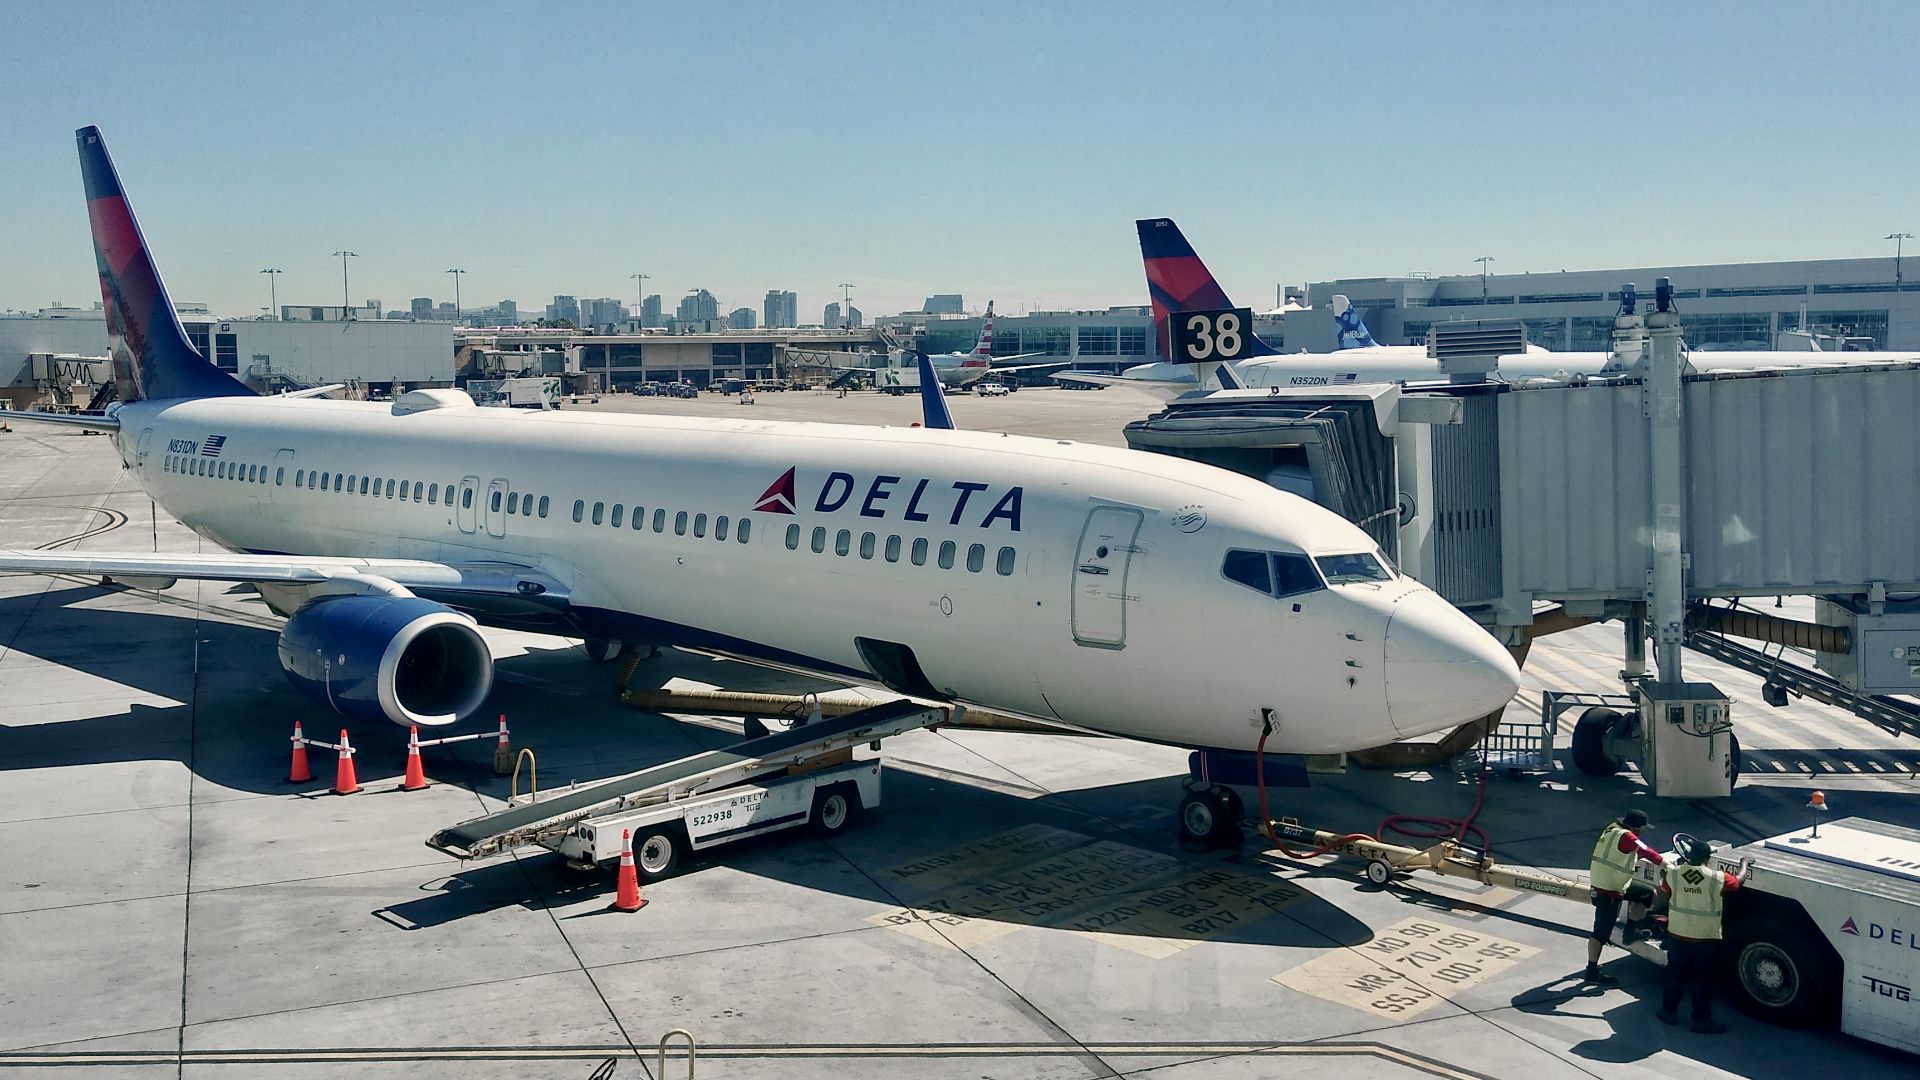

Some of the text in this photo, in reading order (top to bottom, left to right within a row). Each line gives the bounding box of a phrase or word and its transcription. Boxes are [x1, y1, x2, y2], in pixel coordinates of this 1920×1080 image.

[1187, 312, 1242, 359] 38
[1290, 376, 1329, 385] N352DN
[167, 438, 199, 455] N831DN
[814, 471, 1024, 532] DELTA
[740, 791, 769, 804] DELTA
[693, 809, 733, 826] 522938
[1530, 883, 1566, 895] EQUIPPED
[1365, 923, 1441, 954] MD 90
[1870, 922, 1920, 950] DEL
[1344, 967, 1405, 993] MRJ
[1371, 986, 1433, 1013] SSJ
